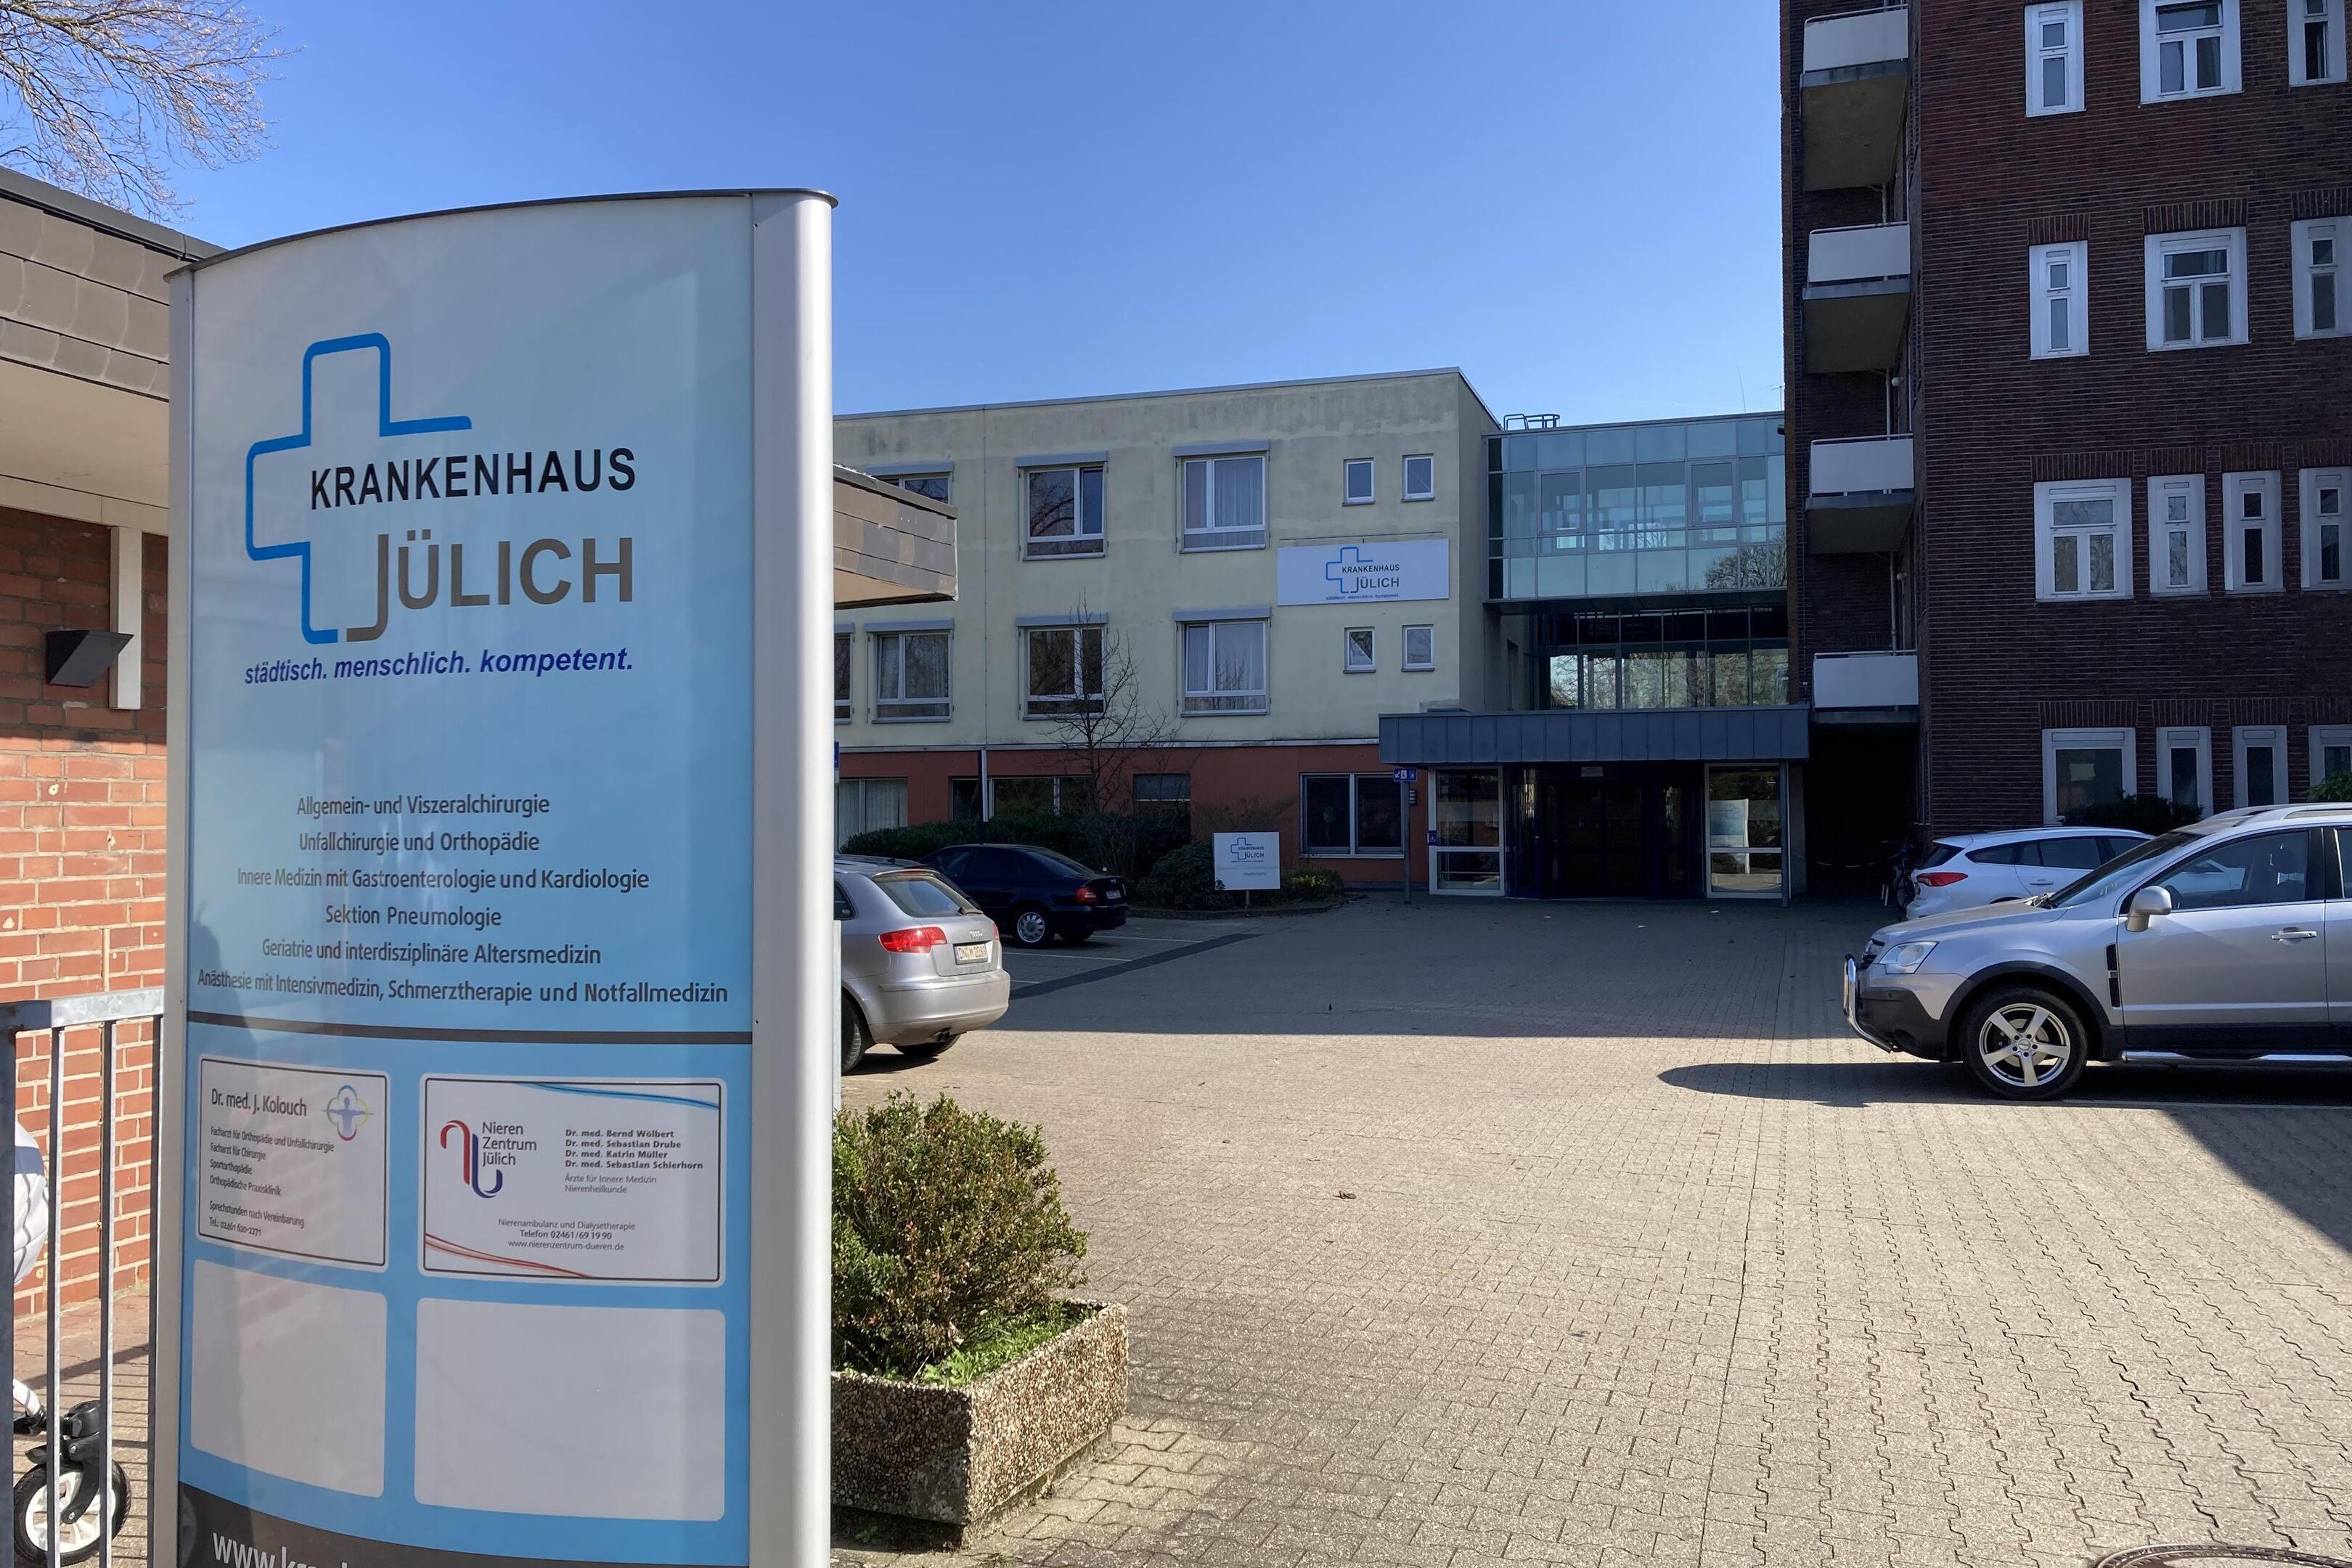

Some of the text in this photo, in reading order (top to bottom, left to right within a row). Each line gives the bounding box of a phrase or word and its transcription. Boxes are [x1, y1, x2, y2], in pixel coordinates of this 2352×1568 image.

[311, 448, 637, 510] KRANKENHAUS
[1342, 564, 1400, 573] KRANKENHAUS
[346, 528, 634, 642] JÜLICH
[1350, 576, 1400, 593] JÜLICH
[244, 648, 634, 684] städtisch. menschlich. kompetent.
[297, 794, 550, 820] Allgemein- und Viszeralchirurgie
[299, 831, 540, 856] Unfallchirurgie und Orthopädie
[237, 867, 650, 894] Innere Medizin mit Gastroenterologie und Kardiologie
[325, 905, 502, 931] Sektion Pneumologie
[262, 939, 602, 966] Geriatrie und interdisziplinäre Altersmedizin
[197, 969, 728, 1006] Anästhesie mit Intensivmedizin, Schmerztherapie und Notfallmedizin
[211, 1088, 307, 1116] Dr. med. J. Kolouch
[481, 1121, 523, 1135] Nieren
[565, 1129, 674, 1138] Dr. med. Bernd Wölbert
[210, 1126, 335, 1153] Facharzt für Orthopädie und Unfallchirurgie
[481, 1136, 537, 1151] Zentrum
[565, 1139, 578, 1148] Dr.
[606, 1140, 650, 1148] Sebastian
[653, 1140, 682, 1148] Drube
[210, 1142, 266, 1161] Facharzt für Chirurgie
[482, 1151, 516, 1167] Jülich
[565, 1149, 669, 1159] Dr. med. Katrin Müller
[210, 1159, 253, 1175] Sportorthopädie
[565, 1159, 703, 1169] Dr. med. Sebastian Schierhorn
[210, 1175, 282, 1196] Orthopädische Praxisklinik
[564, 1172, 657, 1184] Ärzte für Innere Medizin
[564, 1185, 628, 1193] Nierenheilkunde
[209, 1200, 305, 1229] Sprechstunden nach Vereinbarung
[220, 1221, 236, 1232] 02461
[497, 1218, 636, 1232] Nierenambulanz und Dialysetherapie
[520, 1229, 613, 1241] Telefon 02461/69 19 90
[507, 1241, 625, 1251] www.nierenzentrum-dueren.de
